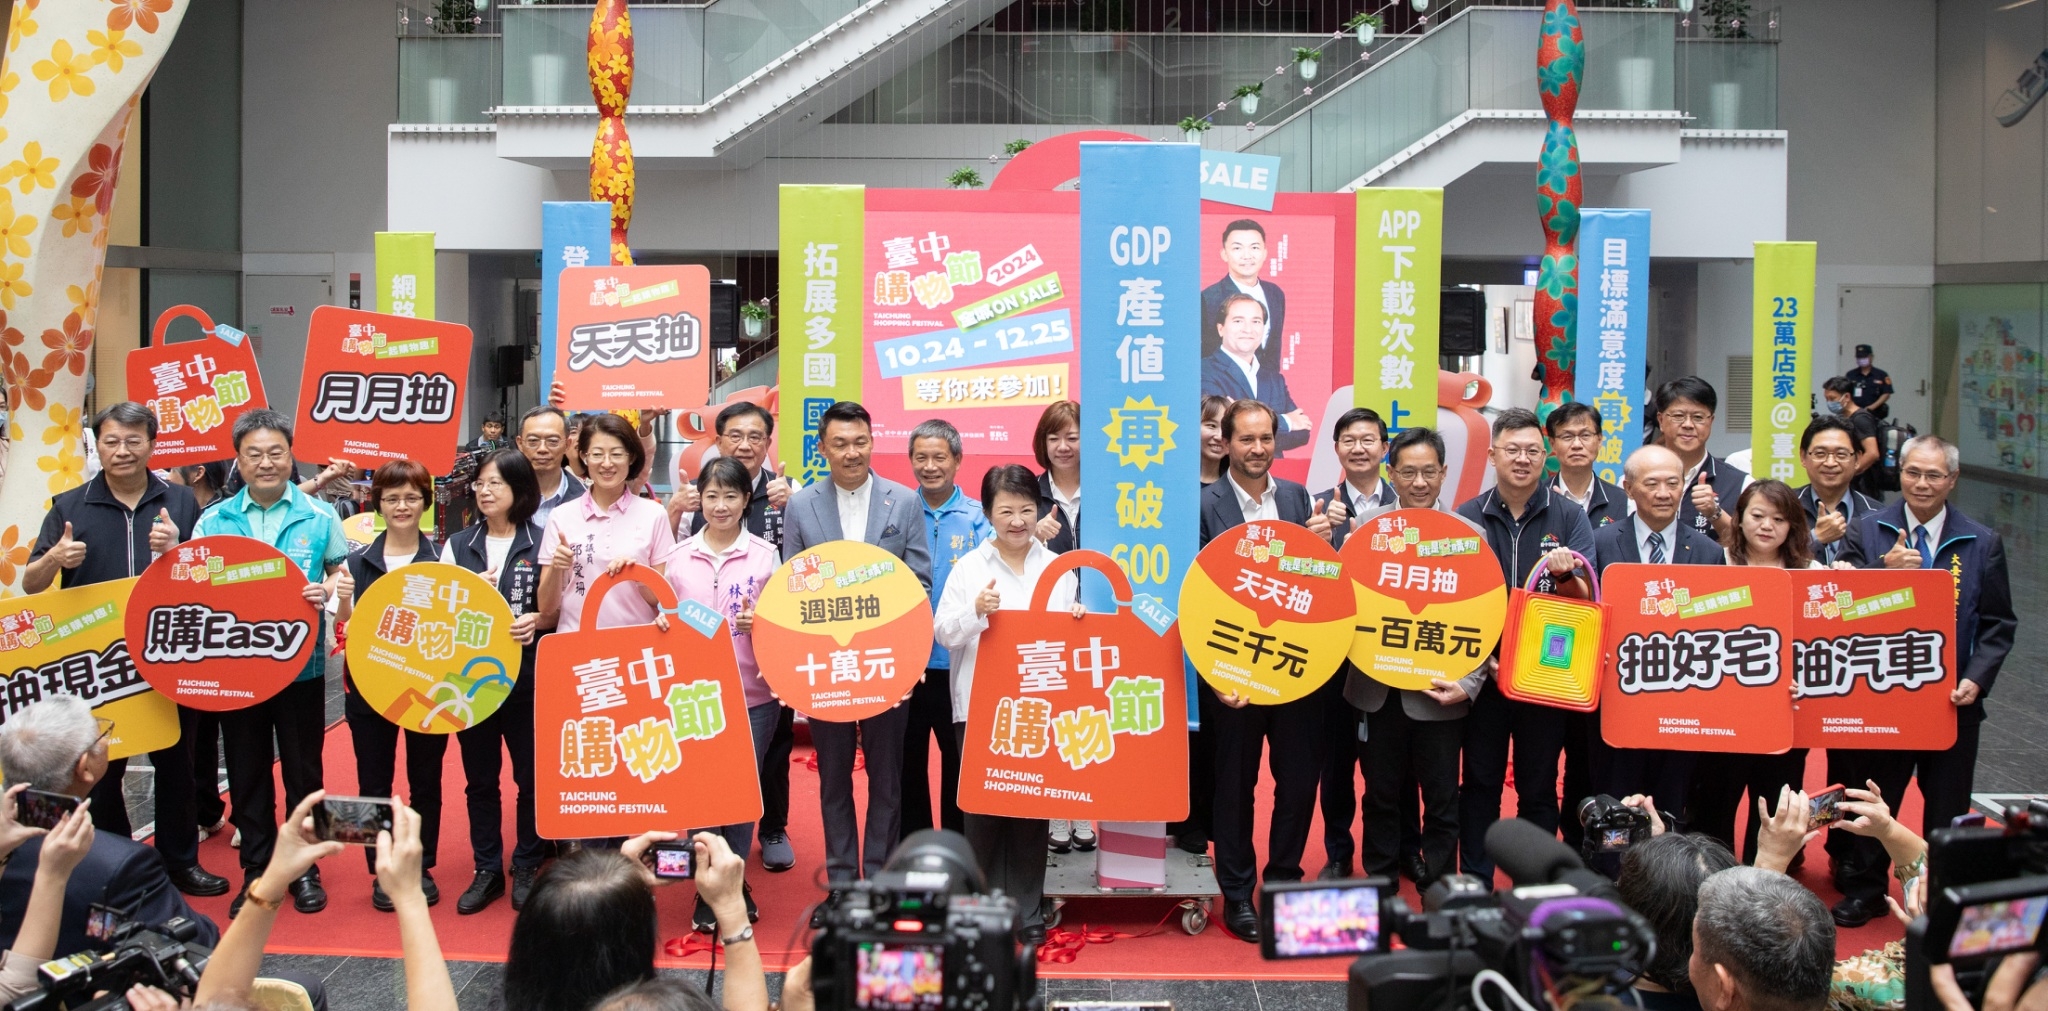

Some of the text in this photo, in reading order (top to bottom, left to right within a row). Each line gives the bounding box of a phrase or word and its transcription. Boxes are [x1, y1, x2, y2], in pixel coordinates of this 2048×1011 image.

[882, 231, 950, 269] 臺中
[990, 249, 1036, 283] 2024
[873, 250, 983, 310] 購物節
[1019, 278, 1060, 305] SALE
[803, 241, 838, 387] 拓展多國
[873, 312, 911, 320] TAICHUNG
[873, 319, 911, 327] SHOPPING
[220, 326, 241, 341] SALE
[348, 323, 376, 337] 臺中
[570, 313, 698, 369] 天天抽
[341, 333, 387, 356] 購物節
[885, 336, 965, 369] 10.24
[995, 319, 1070, 351] 12.25
[150, 353, 216, 396] 臺中
[313, 373, 452, 420] 月月抽
[601, 390, 635, 398] SHOPPING
[152, 445, 218, 456] HOPPING FESTIVAL
[343, 447, 409, 460] SHOPPING FESTIVAL
[344, 440, 380, 449] TAICHUNG
[1246, 524, 1276, 542] 臺中
[1377, 516, 1407, 533] 臺中
[1234, 538, 1286, 564] 購物節
[1371, 527, 1421, 554] 購物節
[178, 545, 211, 563] 臺中
[790, 553, 821, 574] 臺中
[171, 556, 225, 583] 購物節
[787, 560, 837, 593] 購物節
[1377, 562, 1458, 594] 月月抽
[401, 574, 470, 614] 臺中
[1233, 568, 1313, 615] 天天抽
[1644, 577, 1675, 597] 臺中
[1806, 581, 1839, 601] 臺中
[800, 594, 881, 625] 週週抽
[1138, 599, 1171, 628] SALE
[1640, 587, 1690, 617] 購物節
[1803, 590, 1854, 619] 購物節
[683, 604, 718, 630] SALE
[146, 605, 306, 660] 購Easy
[375, 603, 494, 661] 購物節
[1355, 616, 1482, 658] 一百萬元
[369, 645, 407, 664] TAICHUNG
[1206, 619, 1309, 679] 三千元
[1374, 654, 1414, 666] TAICHUNG
[1619, 627, 1776, 691] 抽好宅
[1792, 630, 1940, 693] 抽汽車
[366, 652, 435, 683] SHOPPING FESTIVAL
[795, 647, 896, 687] 十萬元
[1016, 636, 1120, 693] 臺中
[1214, 659, 1252, 678] TAICHUNG
[1374, 663, 1447, 679] SHOPPING FESTIVAL
[176, 687, 255, 698] SHOPPING FESTIVAL
[177, 678, 220, 688] TAICHUNG
[572, 647, 676, 714] 臺中
[1211, 668, 1281, 697] SHOPPING FESTIVAL
[811, 690, 852, 701] TAICHUNG
[811, 695, 887, 709] SHOPPING FESTIVAL
[559, 679, 727, 784] 購物節
[989, 675, 1165, 770] 購物節
[1658, 717, 1700, 726] TAICHUNG
[1658, 726, 1736, 737] SHOPPING FESTIVAL
[1822, 717, 1864, 725] TAICHUNG
[1822, 725, 1900, 734] SHOPPING FESTIVAL
[986, 767, 1044, 784] TAICHUNG
[560, 791, 617, 801] TAICHUNG
[983, 780, 1094, 803] SHOPPING FESTIVAL
[560, 804, 667, 814] SHOPPING FESTIVAL
